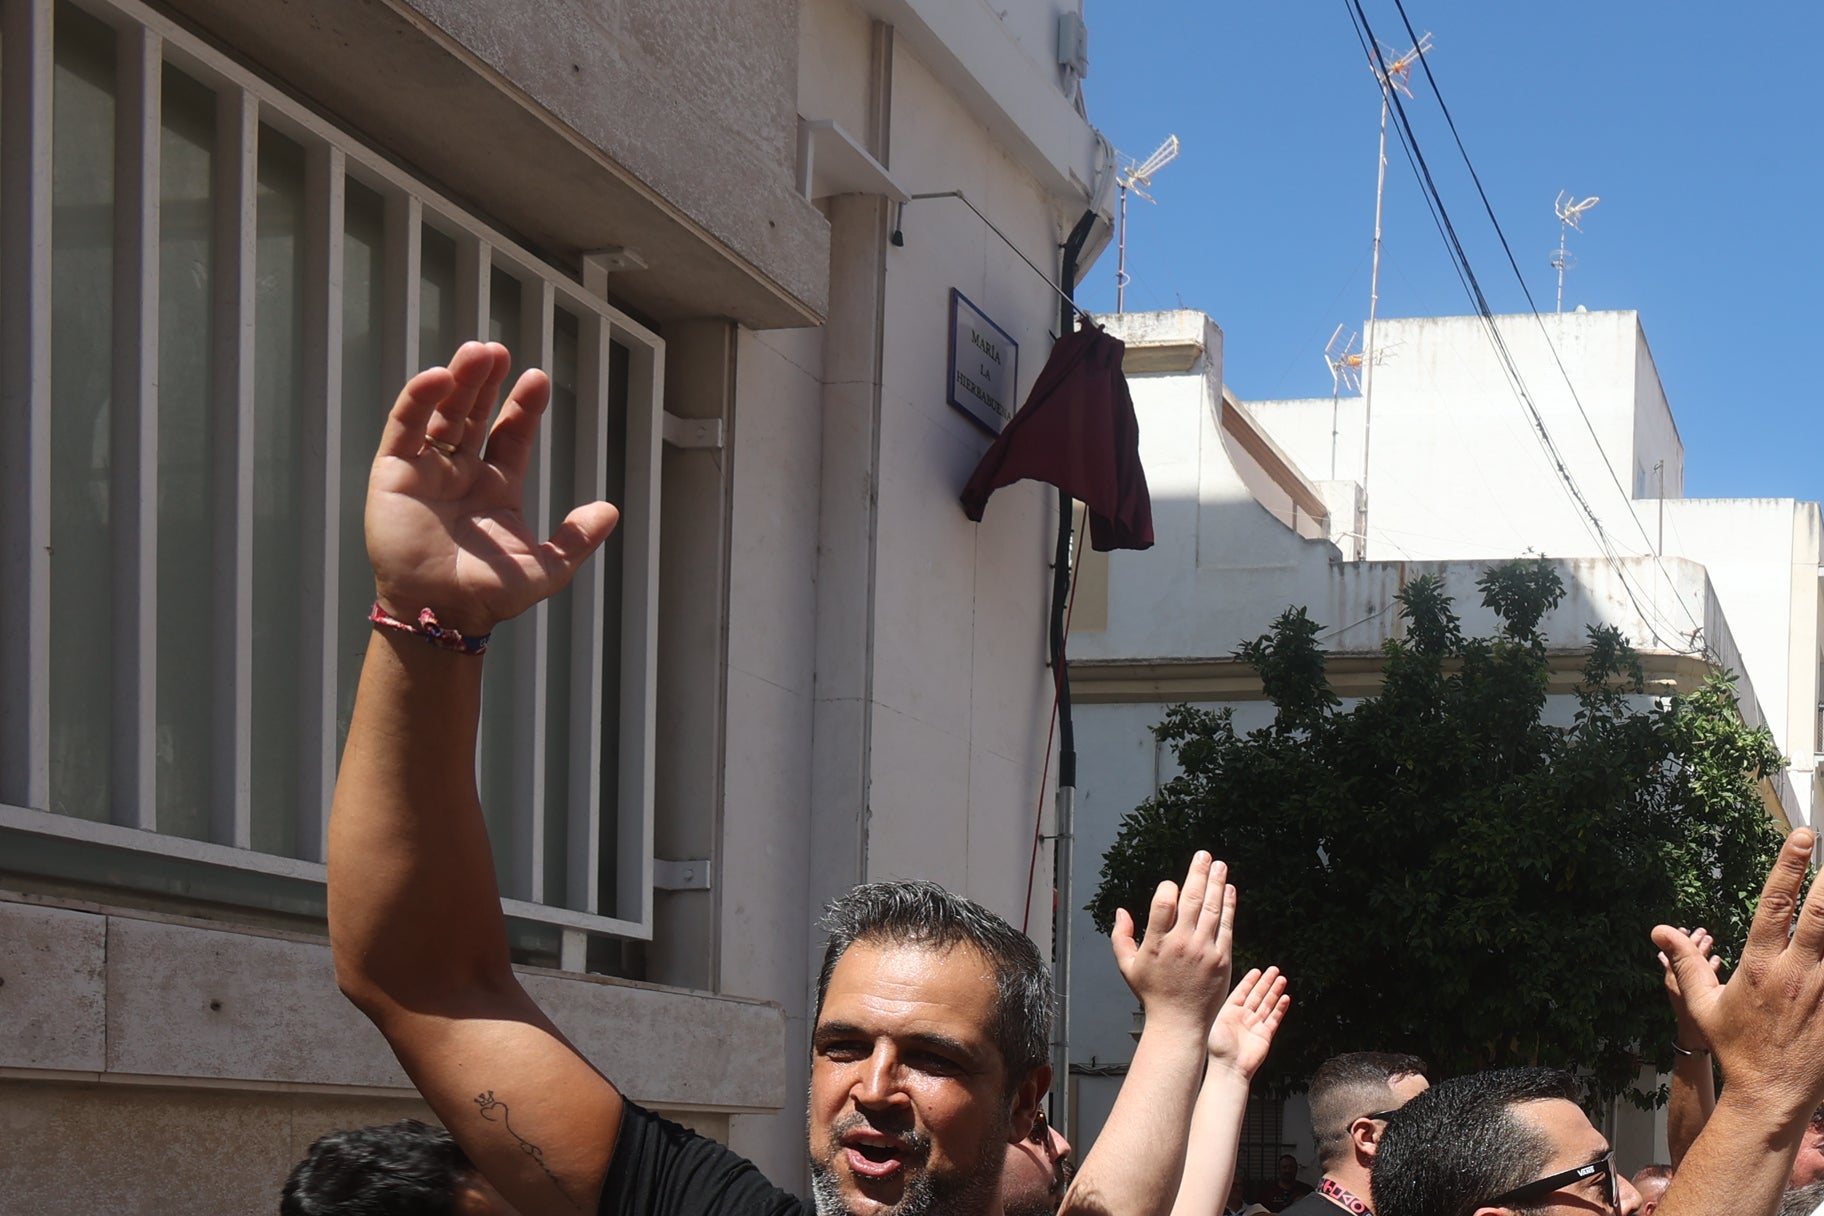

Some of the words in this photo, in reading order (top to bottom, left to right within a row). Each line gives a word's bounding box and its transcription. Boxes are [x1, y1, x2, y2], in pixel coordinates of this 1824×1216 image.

[971, 329, 1001, 366] MARÍA
[980, 364, 991, 381] LA
[957, 370, 1012, 421] HIERBABUENA
